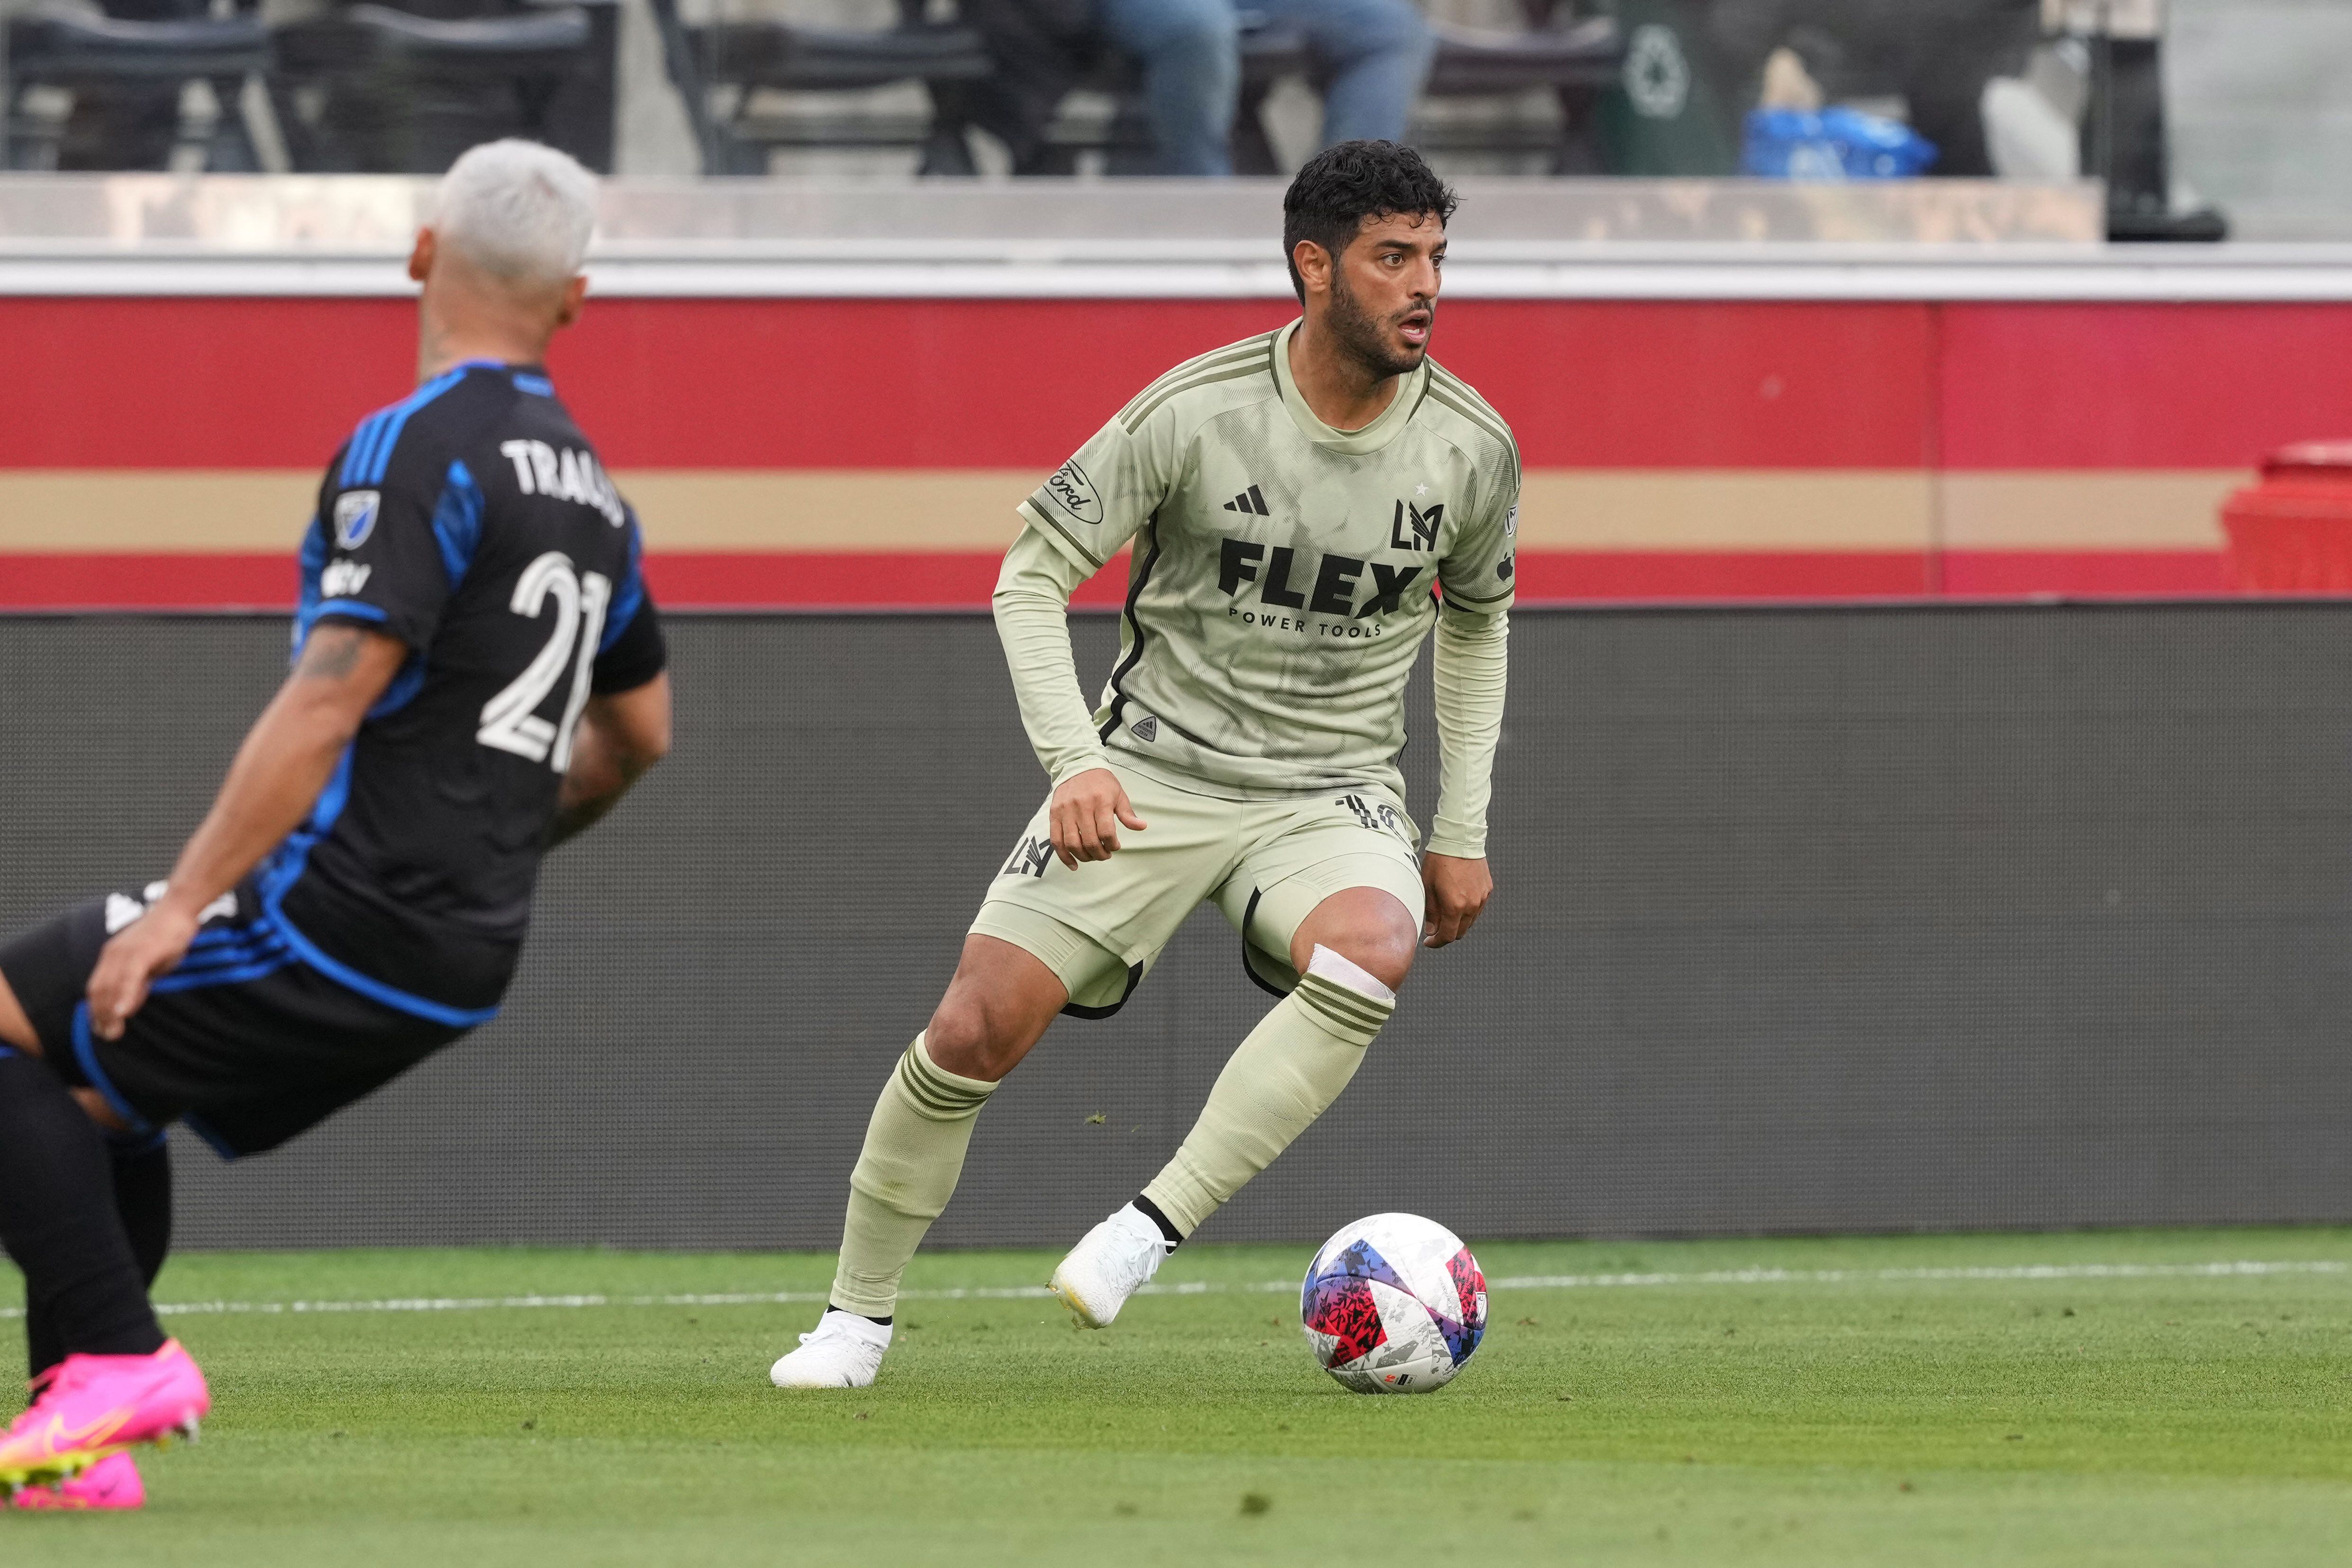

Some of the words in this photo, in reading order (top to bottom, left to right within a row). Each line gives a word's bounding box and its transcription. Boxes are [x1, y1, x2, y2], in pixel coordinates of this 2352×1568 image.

[1049, 462, 1091, 510] Ford
[1217, 537, 1424, 619] FLEX
[1228, 607, 1305, 633] POWER
[1319, 624, 1381, 638] TOOLS
[476, 551, 612, 772] 21
